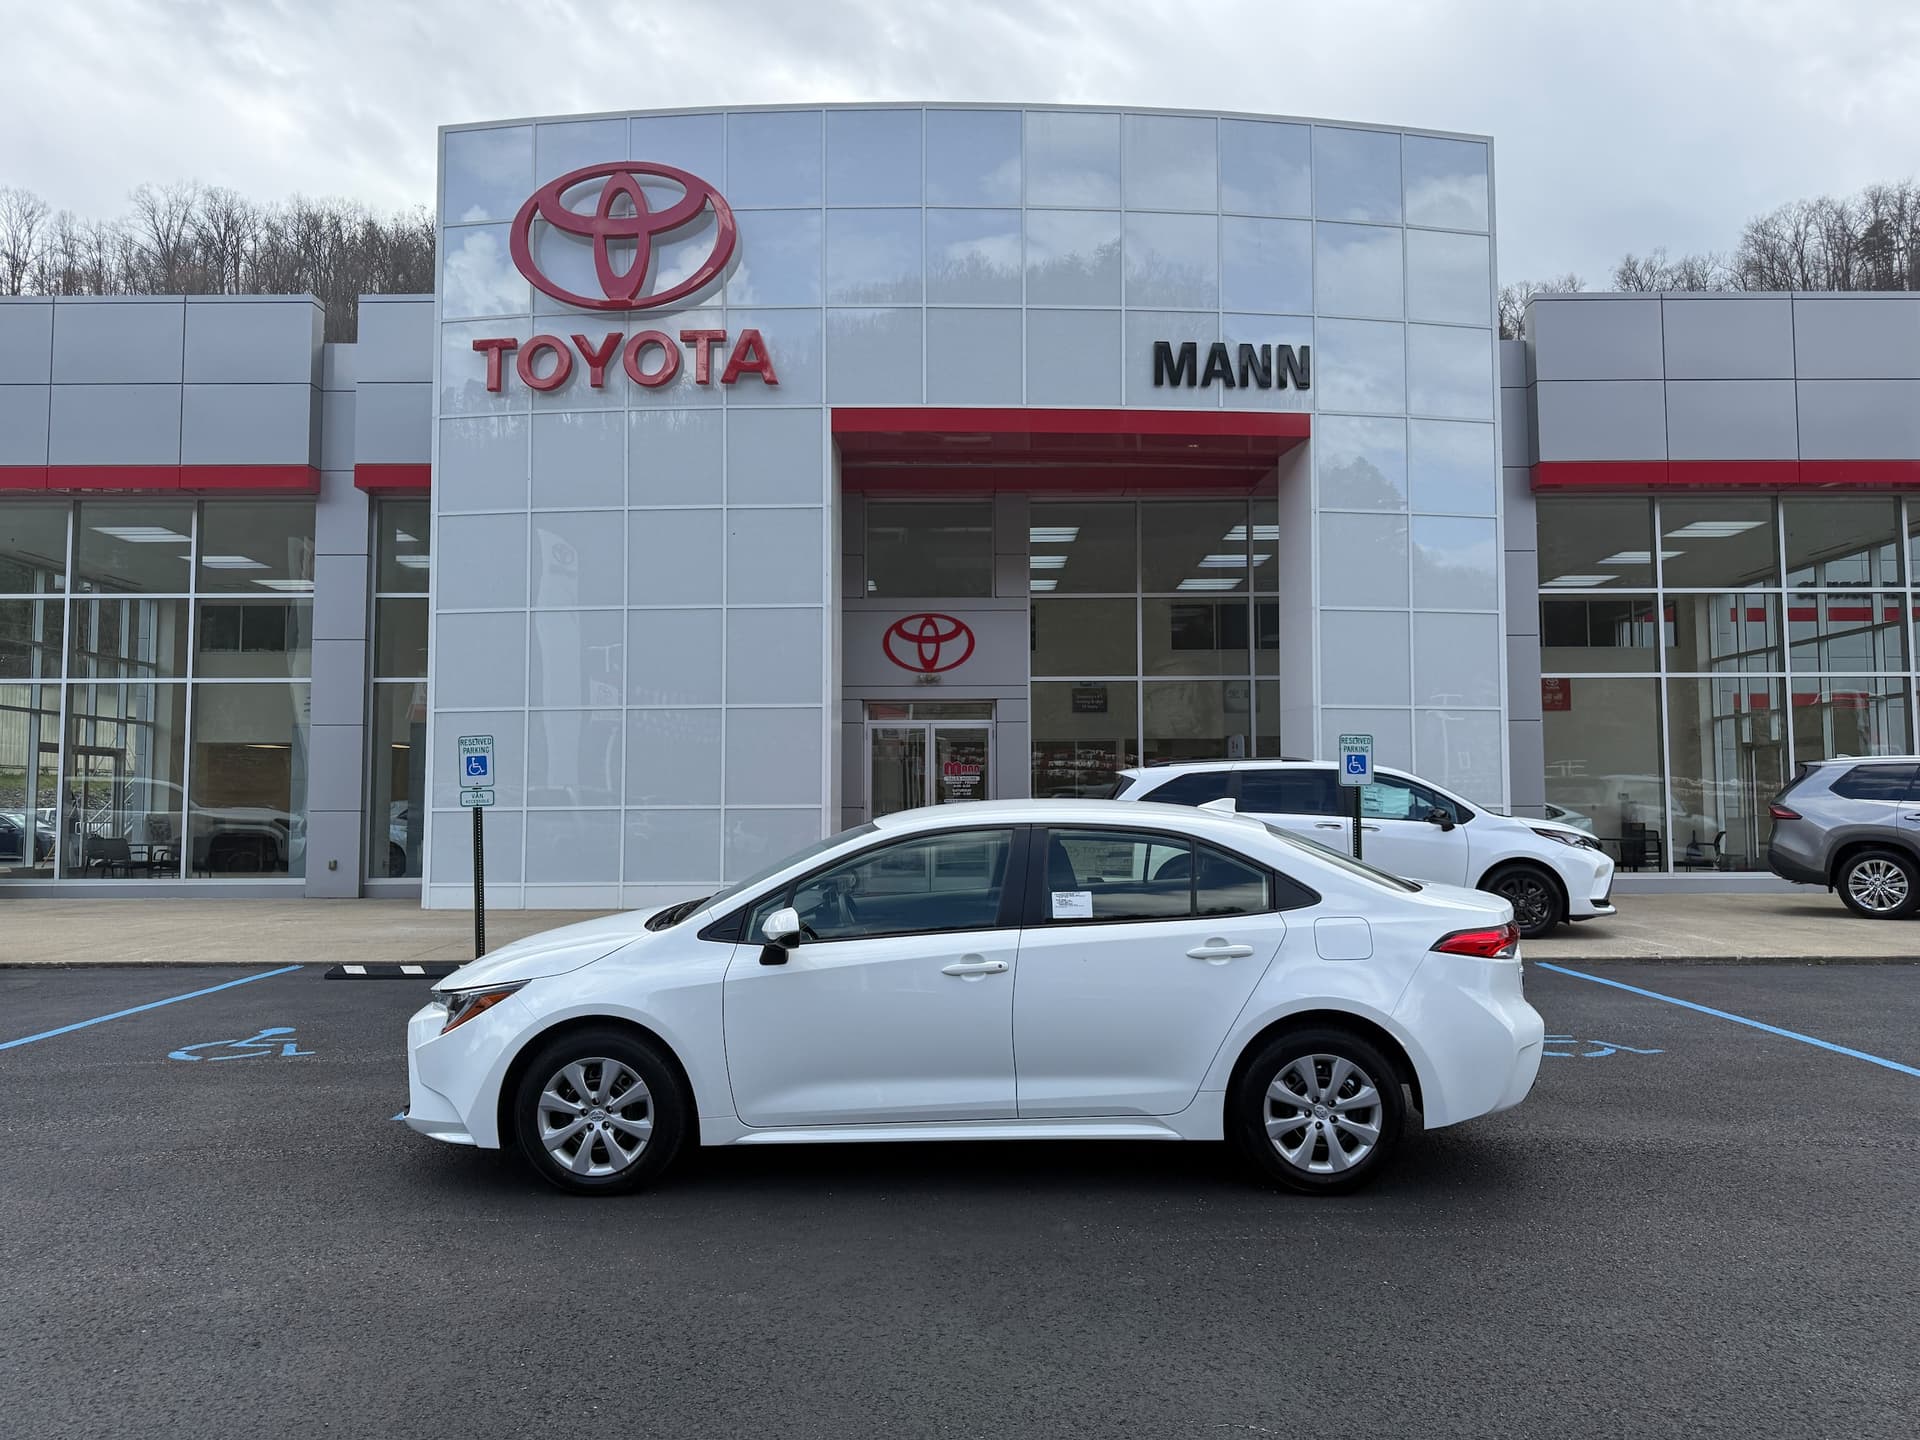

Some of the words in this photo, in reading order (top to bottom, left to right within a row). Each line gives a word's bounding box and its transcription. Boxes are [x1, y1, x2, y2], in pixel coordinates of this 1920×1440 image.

[473, 329, 779, 392] TOYOTA
[1154, 341, 1311, 390] MANN
[460, 738, 492, 746] RESERVED
[1341, 737, 1371, 745] RESERVED
[463, 746, 490, 754] PARKING
[1343, 745, 1369, 753] PARKING
